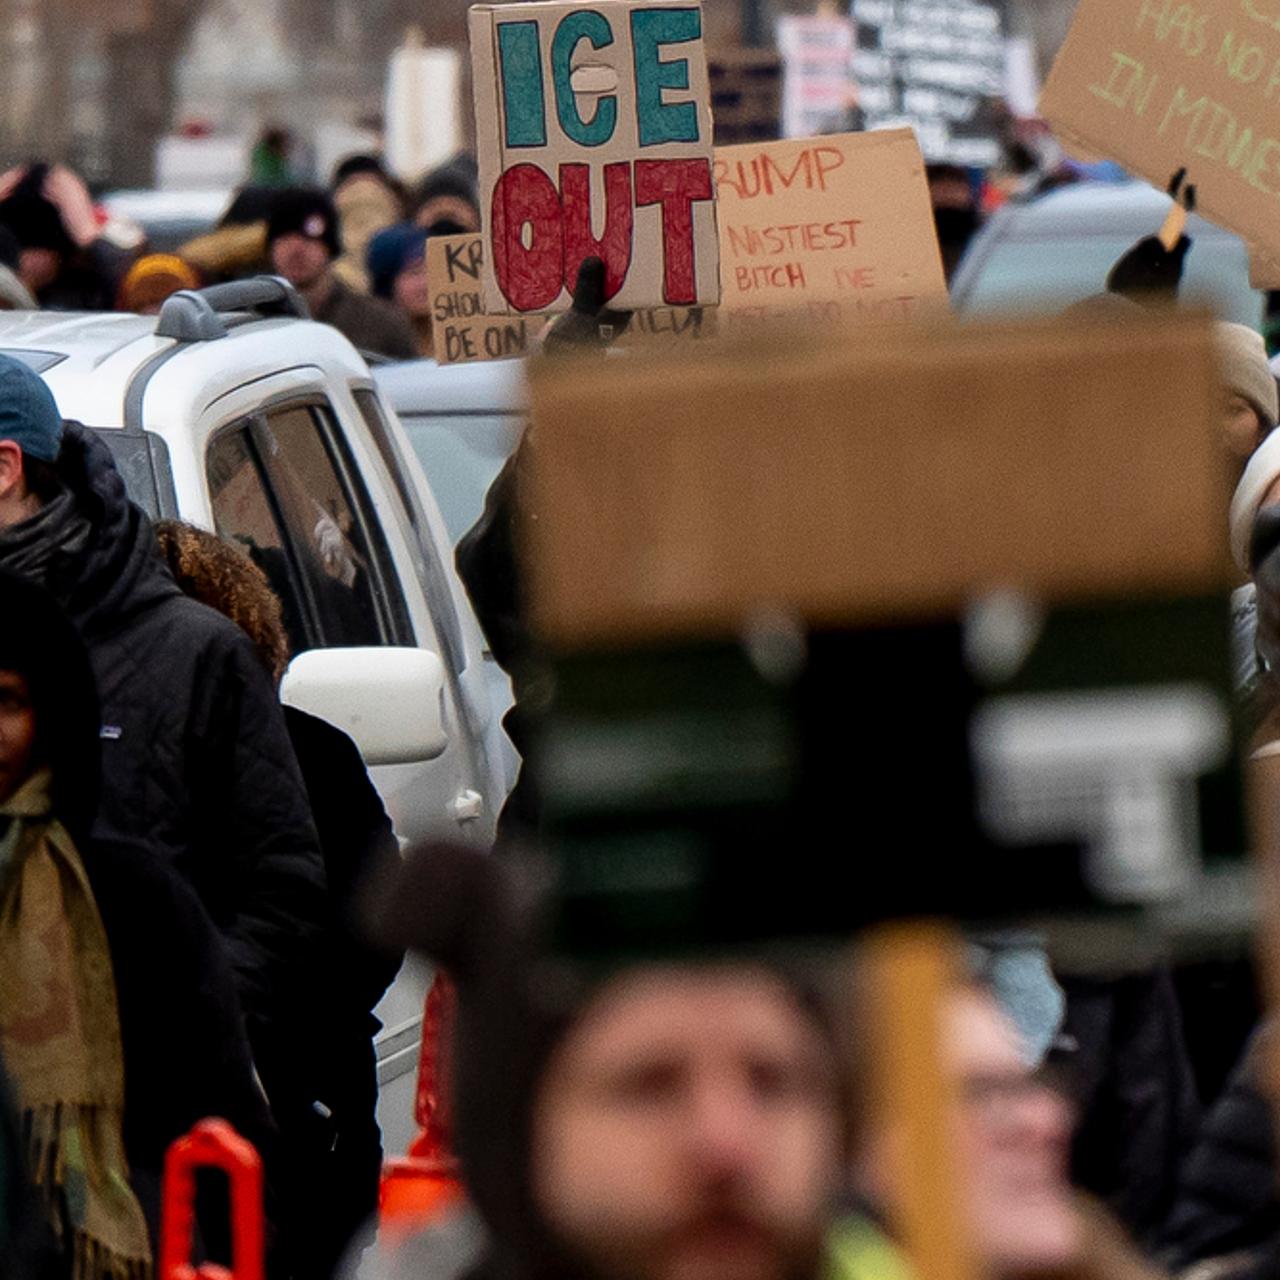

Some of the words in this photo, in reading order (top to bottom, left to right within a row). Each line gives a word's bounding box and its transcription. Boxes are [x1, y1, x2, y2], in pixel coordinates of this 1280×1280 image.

[496, 6, 702, 149] ICE
[1089, 50, 1158, 117] IN
[1214, 32, 1266, 84] NO
[490, 156, 714, 313] OUT
[735, 261, 807, 292] BITCH
[444, 325, 479, 361] BE
[484, 318, 527, 359] ON
